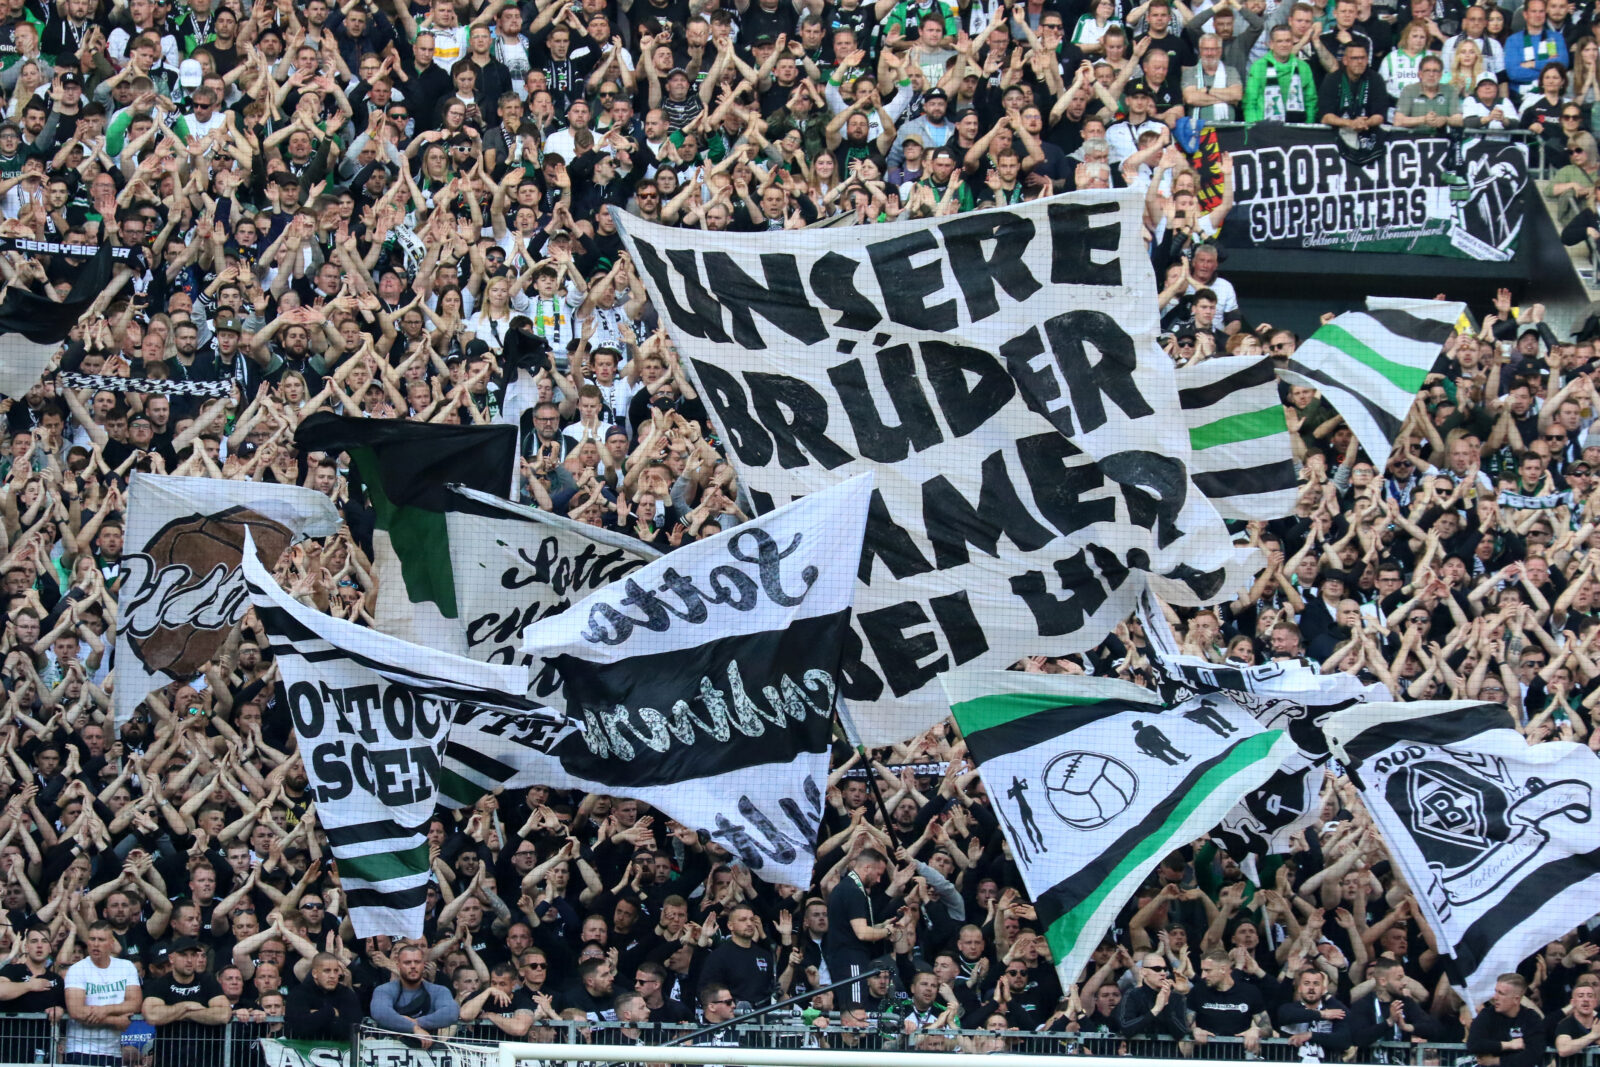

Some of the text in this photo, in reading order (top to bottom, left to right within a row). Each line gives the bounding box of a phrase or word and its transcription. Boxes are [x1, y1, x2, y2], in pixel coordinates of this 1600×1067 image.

[1230, 138, 1450, 204] DROPKICK
[15, 239, 131, 258] DERBYSIEER
[1250, 188, 1427, 243] SUPPORTERS
[632, 201, 1123, 350] UNSERE
[690, 310, 1155, 470] BRÜDER
